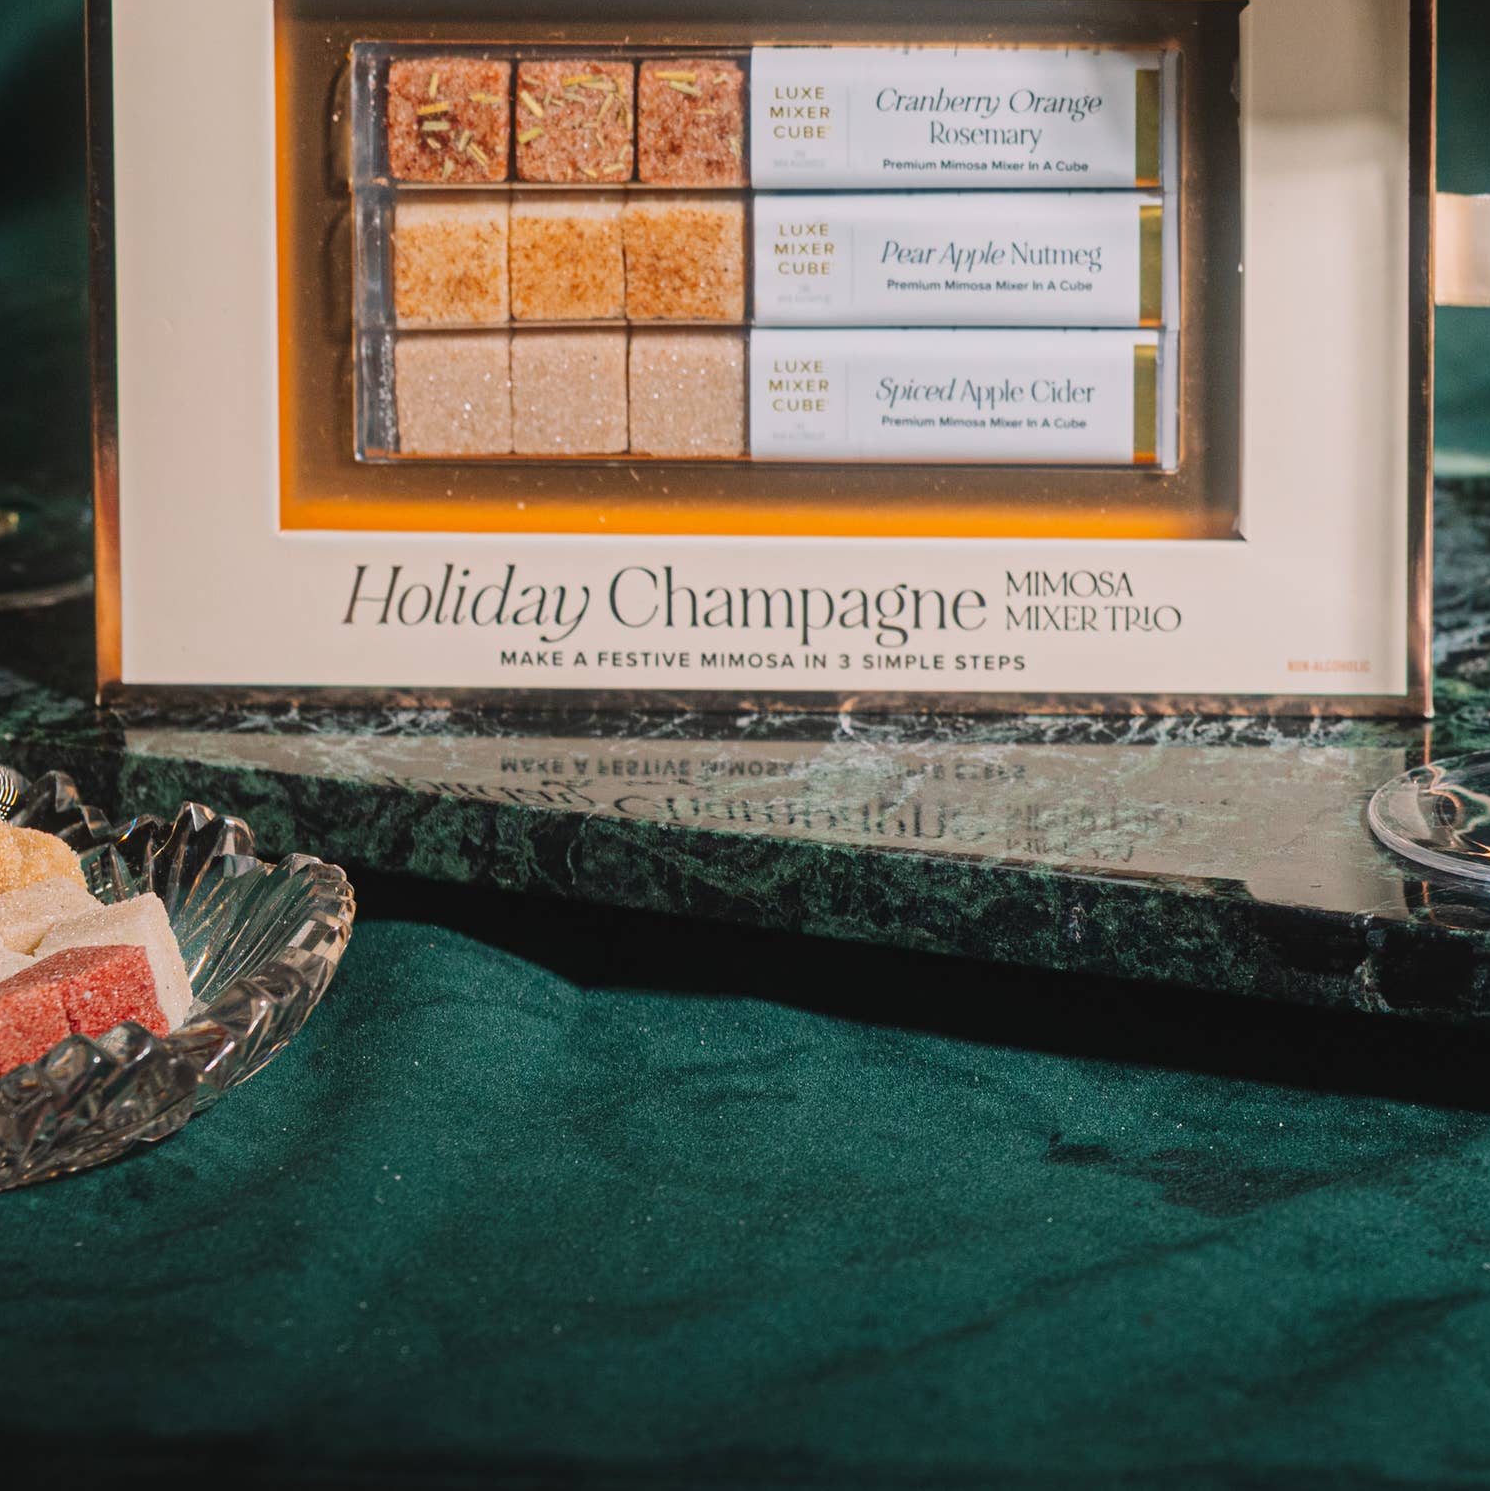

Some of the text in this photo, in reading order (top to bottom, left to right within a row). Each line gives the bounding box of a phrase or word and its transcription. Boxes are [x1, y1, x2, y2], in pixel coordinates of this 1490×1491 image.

[774, 86, 825, 100] LUXE
[769, 105, 830, 119] MIXER
[875, 87, 1103, 123] Cranberry Orange
[930, 121, 1043, 154] Rosemary
[882, 158, 1090, 173] Premium Mimosa Mixer In A Cube
[779, 222, 829, 237] LUXE
[774, 242, 835, 256] MIXER
[881, 240, 1102, 273] Pear Apple Nutmeg
[886, 278, 1094, 292] Premium Mimosa Mixer In A Cube
[773, 360, 823, 374] LUXE
[768, 379, 829, 392] MIXER
[875, 377, 1096, 411] Spiced Apple Cider
[881, 414, 1088, 429] Premium Mimosa Mixer In A Cube
[1005, 570, 1134, 598] MIMOSA
[342, 562, 986, 647] Holiday Champagne
[1005, 605, 1182, 632] MIXER TRIO
[500, 650, 1026, 671] MAKE A FESTIVE MIMOSA IN 3 SIMPLE STEPS
